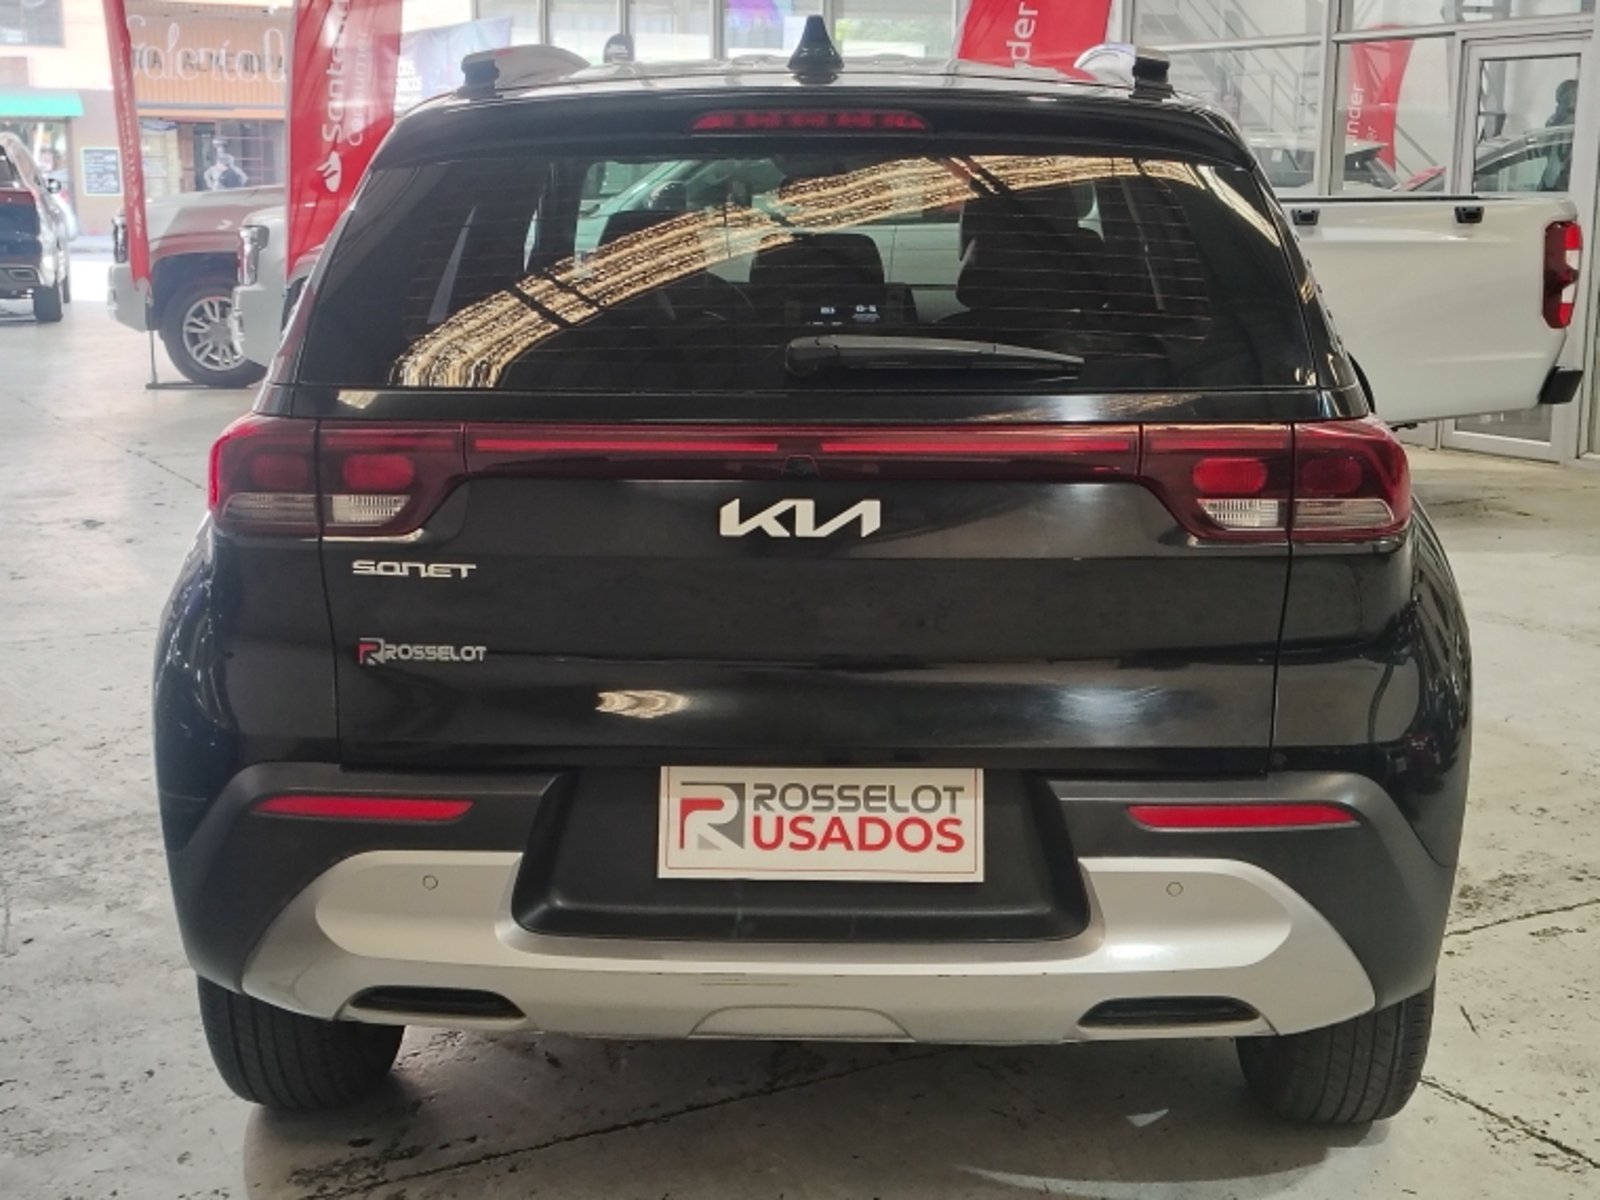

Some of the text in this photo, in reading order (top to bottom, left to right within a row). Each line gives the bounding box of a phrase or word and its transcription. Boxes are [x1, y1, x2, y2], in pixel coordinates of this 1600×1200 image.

[719, 498, 881, 538] KIA
[352, 559, 477, 579] SONET
[384, 644, 487, 662] ROSSELOT
[753, 782, 965, 814] ROSSELOT
[752, 815, 965, 854] USADOS
